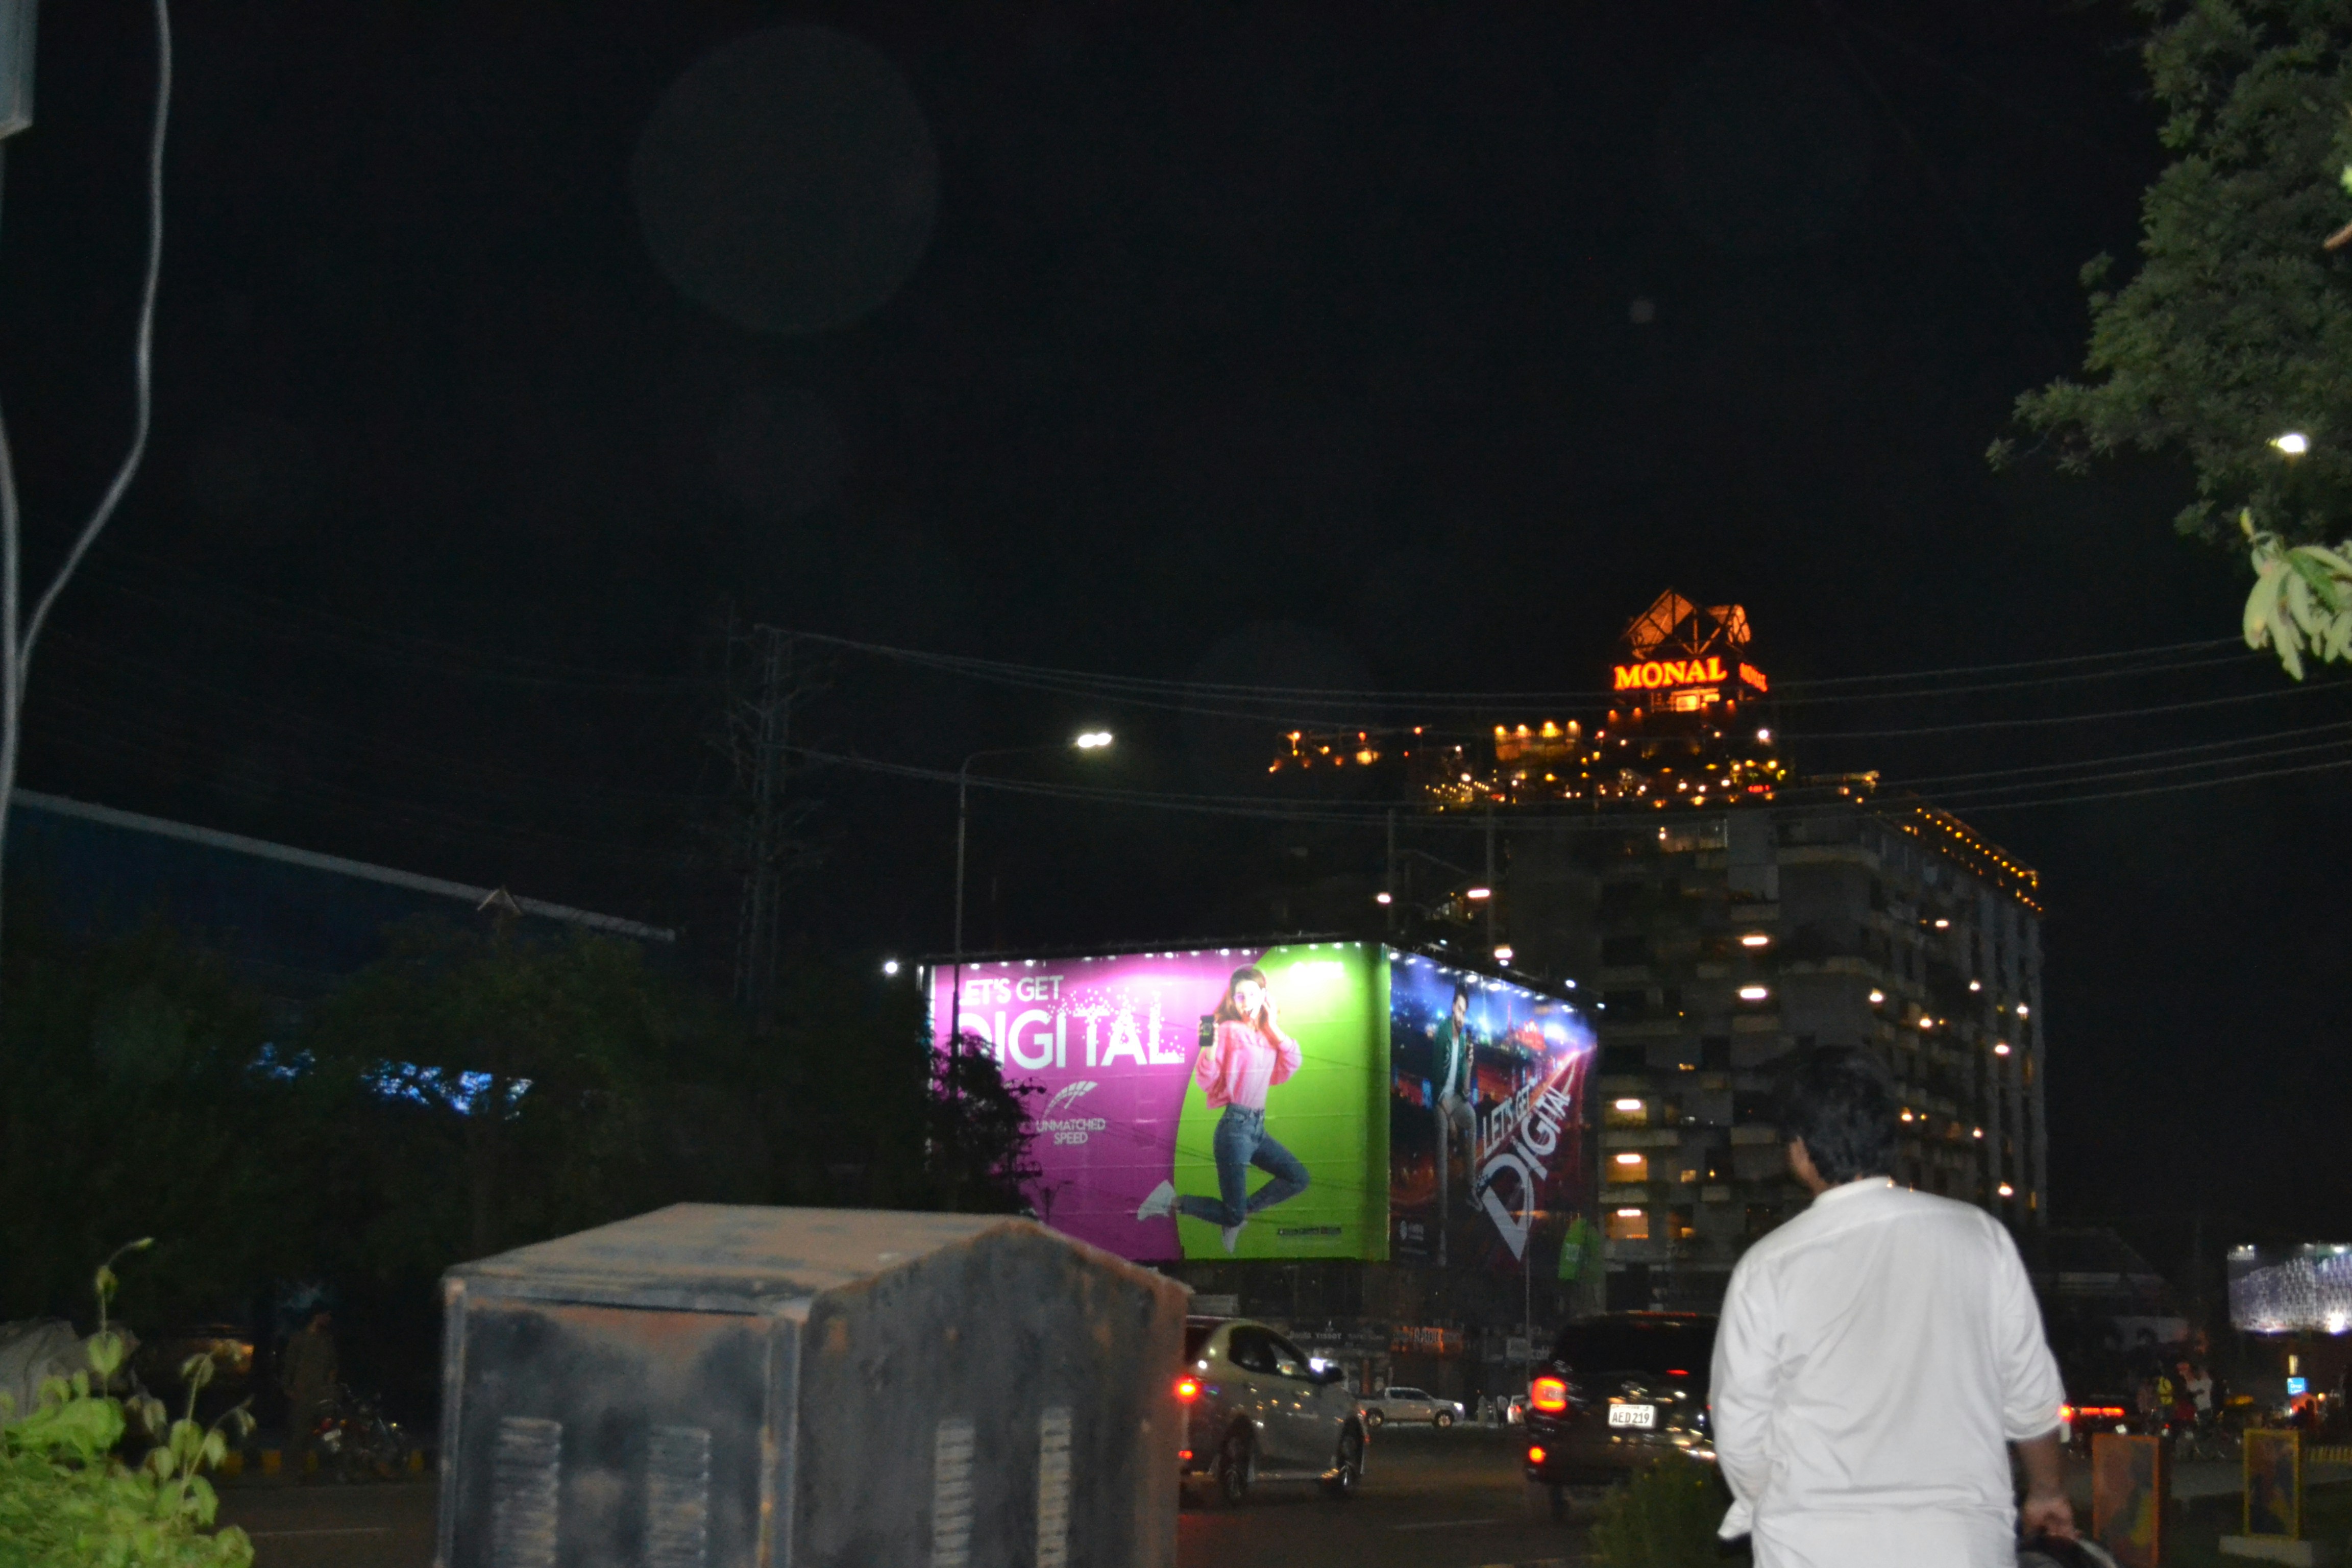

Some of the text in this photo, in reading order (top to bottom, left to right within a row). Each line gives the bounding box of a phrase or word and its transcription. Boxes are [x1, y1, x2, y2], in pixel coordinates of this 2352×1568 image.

[1614, 656, 1727, 690] MONAL
[1016, 975, 1064, 1002] GET
[958, 993, 1185, 1072] DIGITAL
[1036, 1118, 1106, 1132] UNMATCHED
[1483, 1085, 1530, 1159] LET'S GET
[1054, 1132, 1088, 1144] SPEED
[1481, 1086, 1571, 1262] DIGITAL
[1612, 1412, 1650, 1424] AED 219
